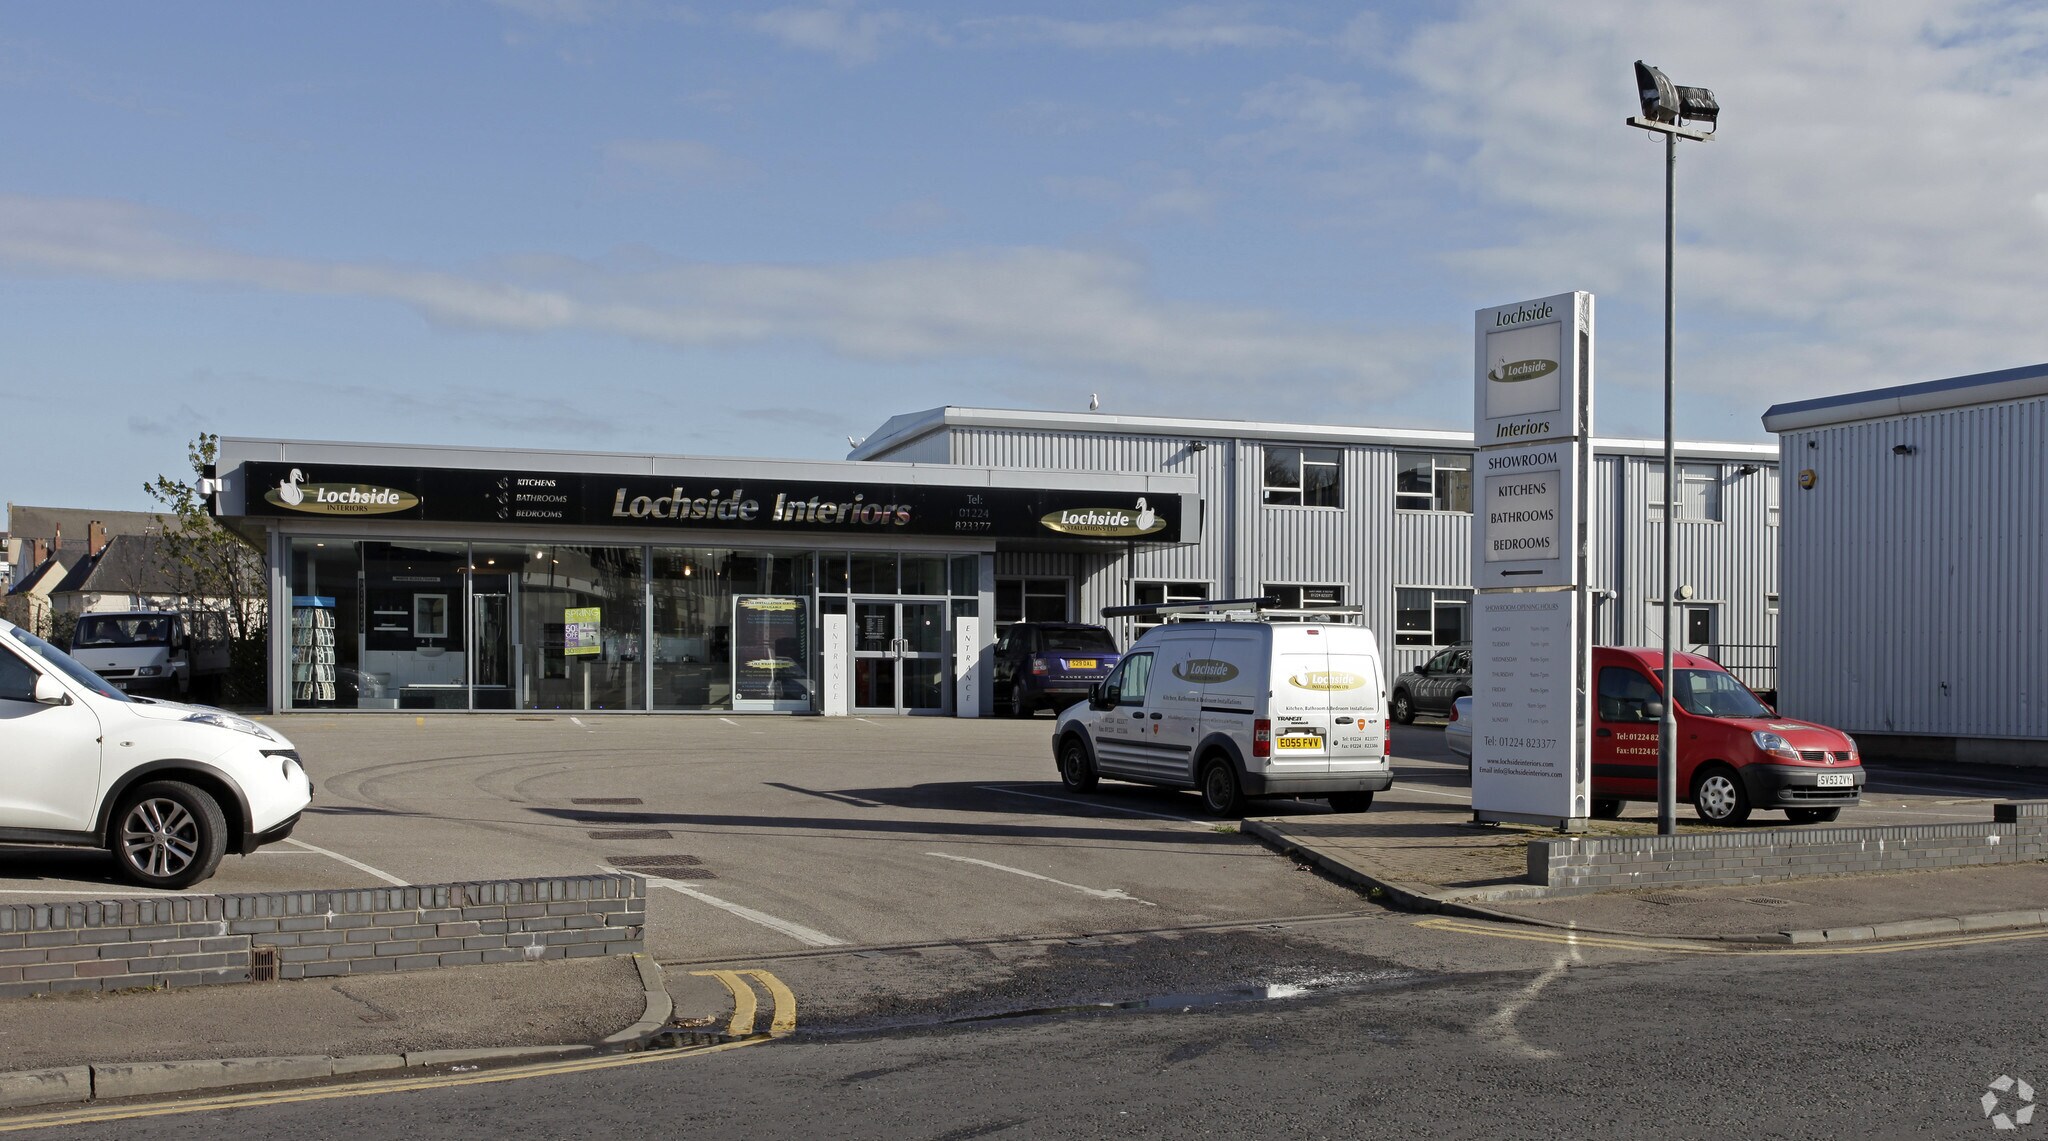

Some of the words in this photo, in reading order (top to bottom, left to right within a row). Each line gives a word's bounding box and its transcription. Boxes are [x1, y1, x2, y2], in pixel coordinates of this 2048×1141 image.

[1496, 302, 1553, 326] Lochside
[1508, 360, 1546, 376] Lochside
[1496, 418, 1550, 438] Interiors
[1488, 452, 1557, 470] SHOWROOM
[517, 478, 556, 487] KITCHENS
[317, 488, 400, 504] Lochside
[1498, 482, 1546, 497] KITCHENS
[516, 494, 568, 502] BATHROOMS
[966, 494, 983, 504] Tel:
[612, 487, 760, 521] Lochside
[772, 492, 912, 526] Interiors
[959, 508, 989, 518] 01224
[516, 510, 562, 518] BEDROOMS
[1061, 510, 1129, 526] Lochside
[1490, 509, 1554, 524] BATHROOMS
[955, 521, 991, 530] 823377
[1494, 536, 1550, 551] BEDROOMS
[565, 608, 599, 617] SPRING
[832, 622, 840, 700] ENTRANCE
[1190, 662, 1228, 675] Lochside
[1312, 674, 1354, 684] Lochside
[1303, 738, 1318, 747] FVV
[1484, 736, 1497, 746] Tel:
[1499, 737, 1524, 747] 01224
[1526, 738, 1557, 749] 823377
[1486, 758, 1554, 767] www.lochsideinteriors.com
[1493, 767, 1563, 778] info@lochsideinteriors.com
[1820, 776, 1838, 784] SV53
[1839, 776, 1850, 784] ZVY
